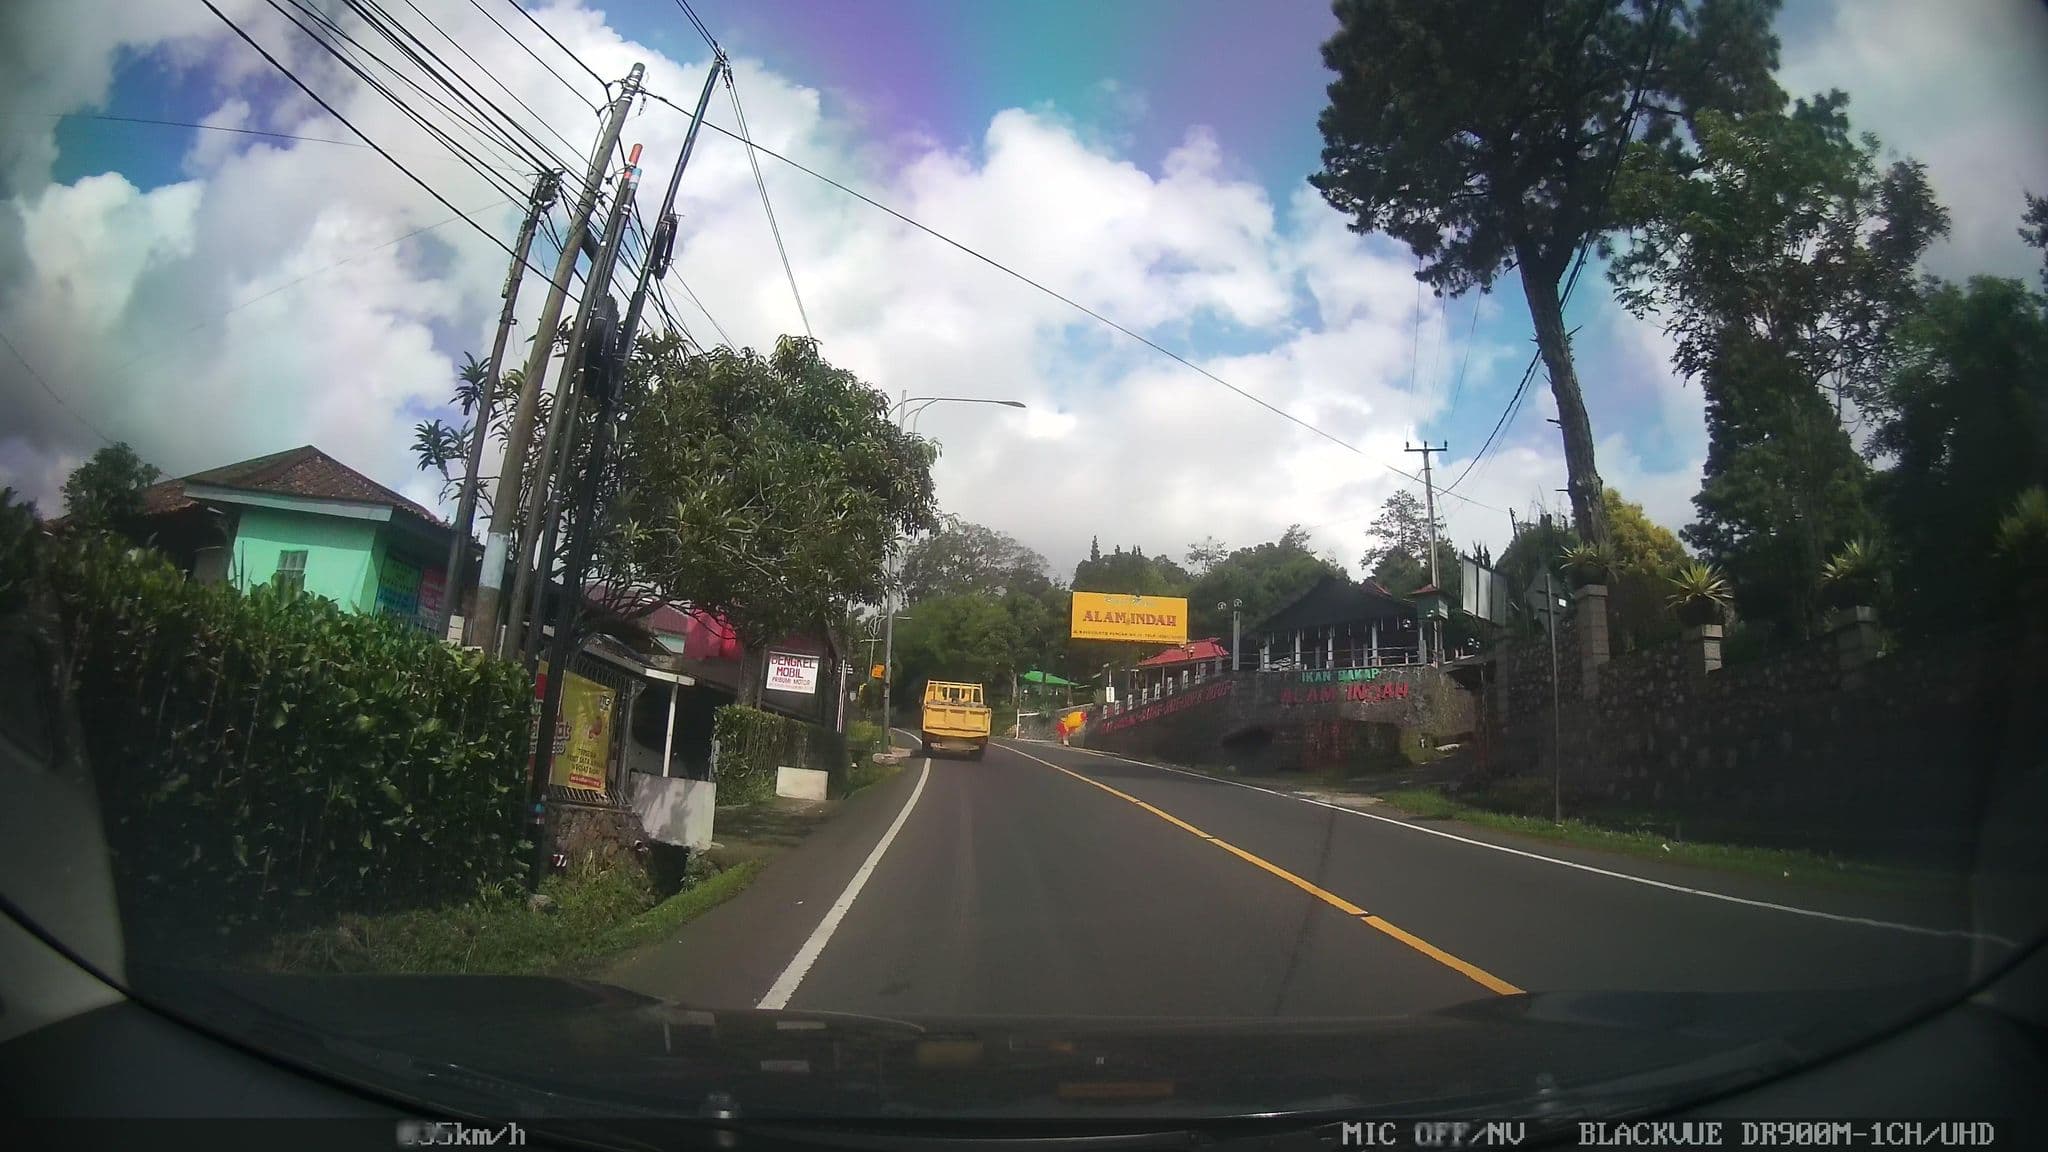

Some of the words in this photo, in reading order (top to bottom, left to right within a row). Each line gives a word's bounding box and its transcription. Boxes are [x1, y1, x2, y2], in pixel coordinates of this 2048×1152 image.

[1083, 610, 1127, 624] ALAM
[1129, 612, 1177, 627] INDAH
[771, 655, 816, 670] BENGKEL
[776, 666, 804, 679] MOBIL
